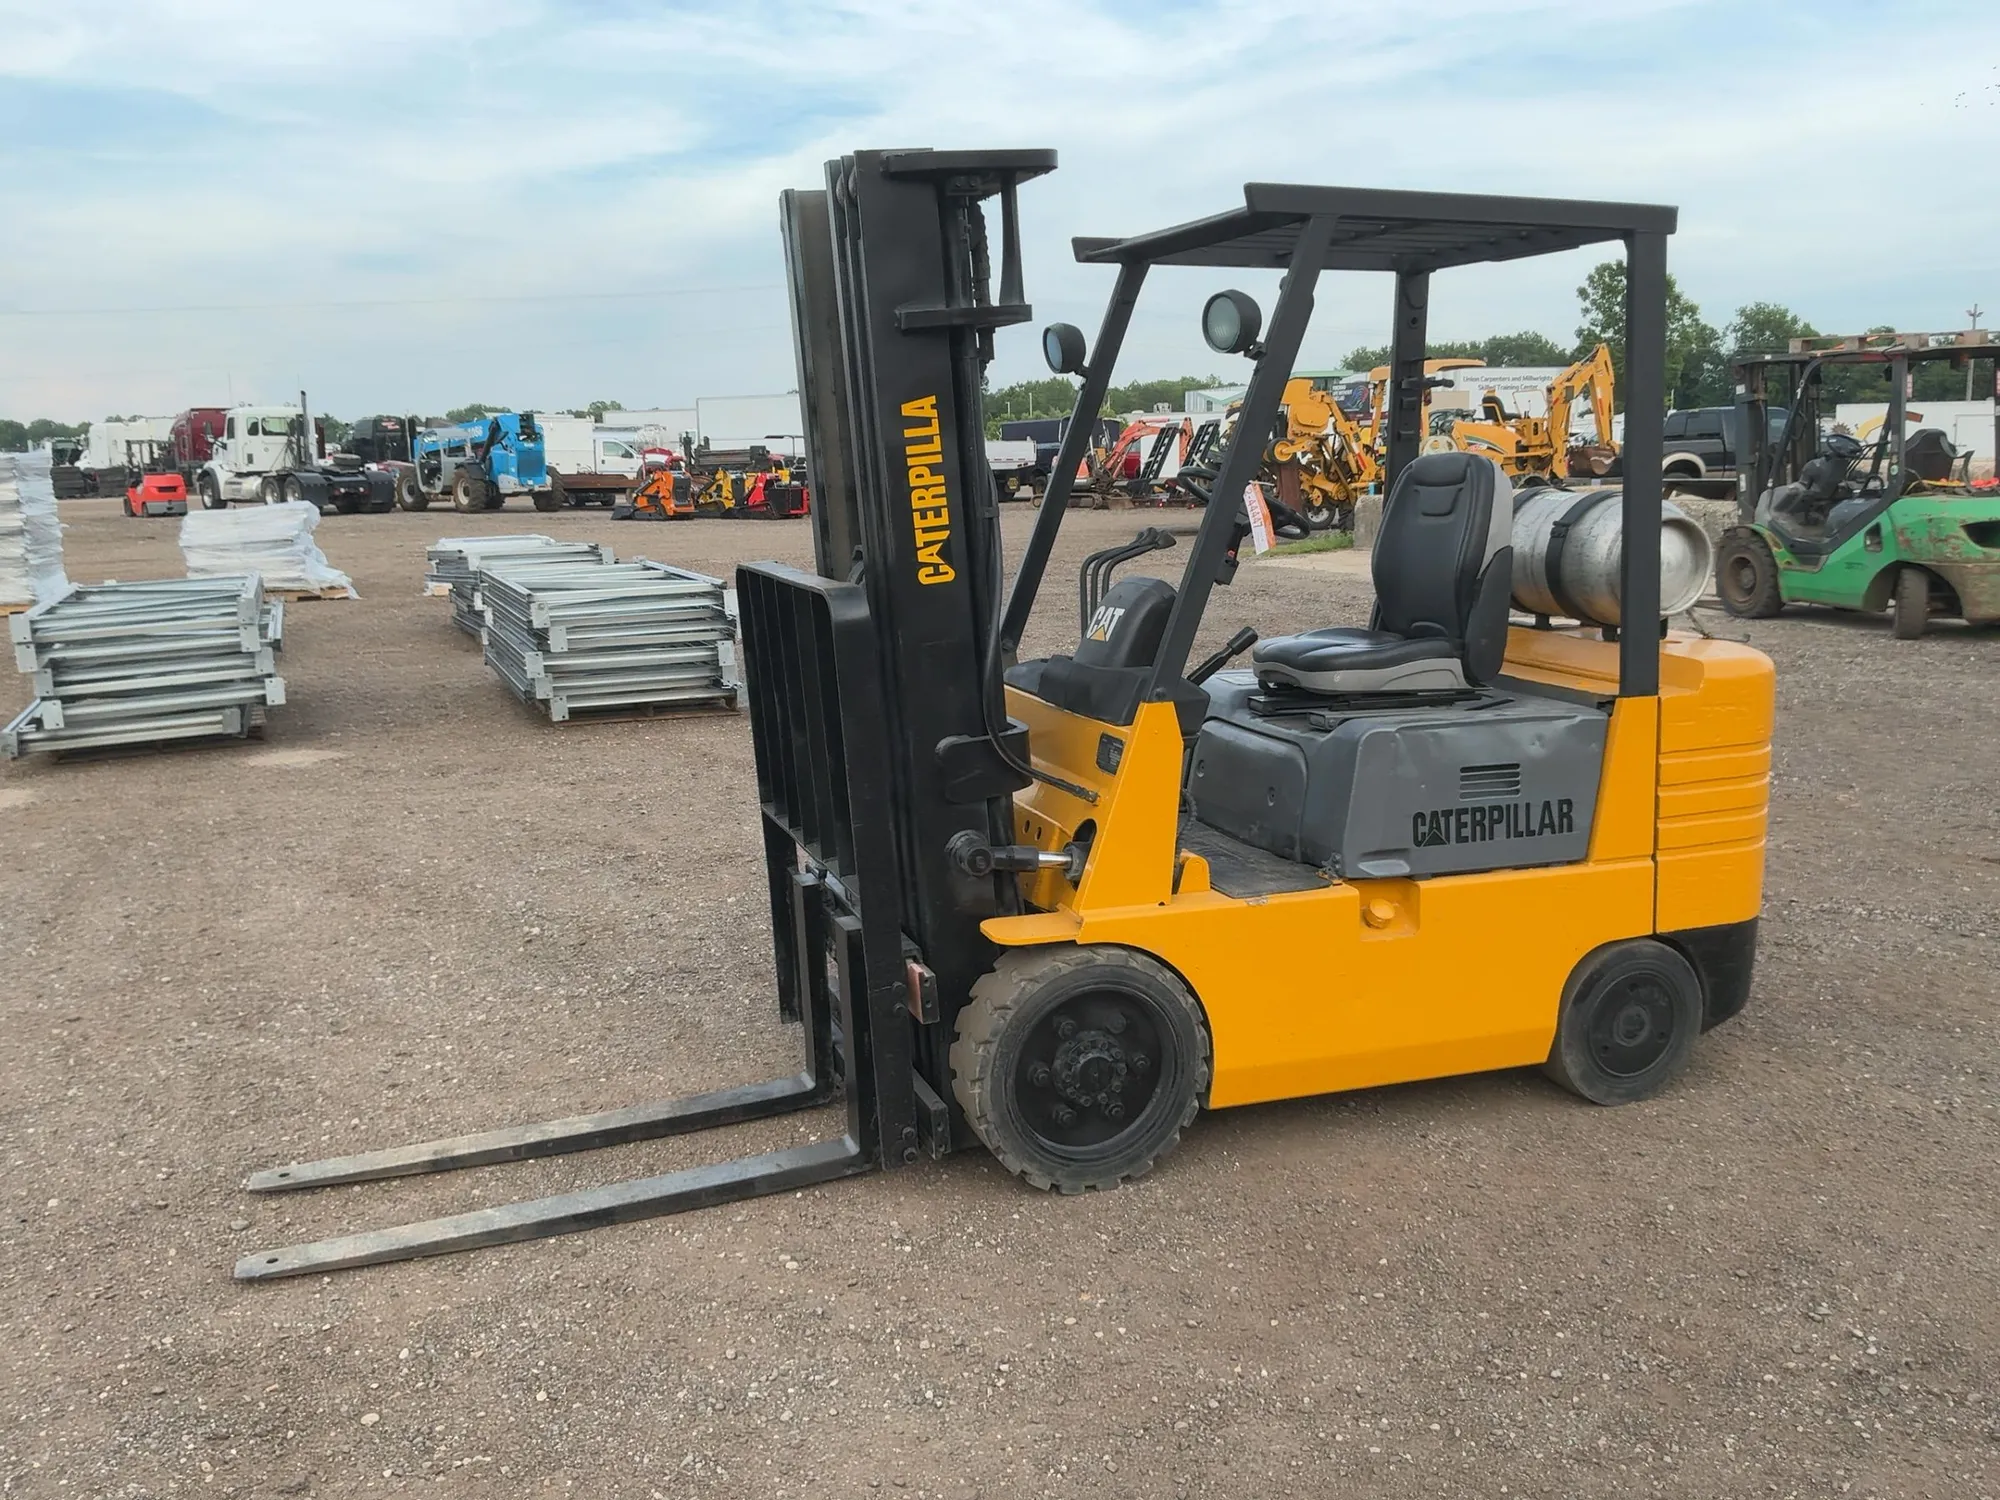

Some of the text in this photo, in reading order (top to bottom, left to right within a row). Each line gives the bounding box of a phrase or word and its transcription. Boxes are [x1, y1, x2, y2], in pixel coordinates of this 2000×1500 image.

[1480, 375, 1511, 383] Carpenters
[1523, 375, 1553, 383] Millwrights
[1497, 384, 1519, 392] Training
[901, 395, 956, 585] CATERPILLA
[1086, 605, 1126, 642] CAT
[1412, 798, 1574, 848] CATERPILLAR
